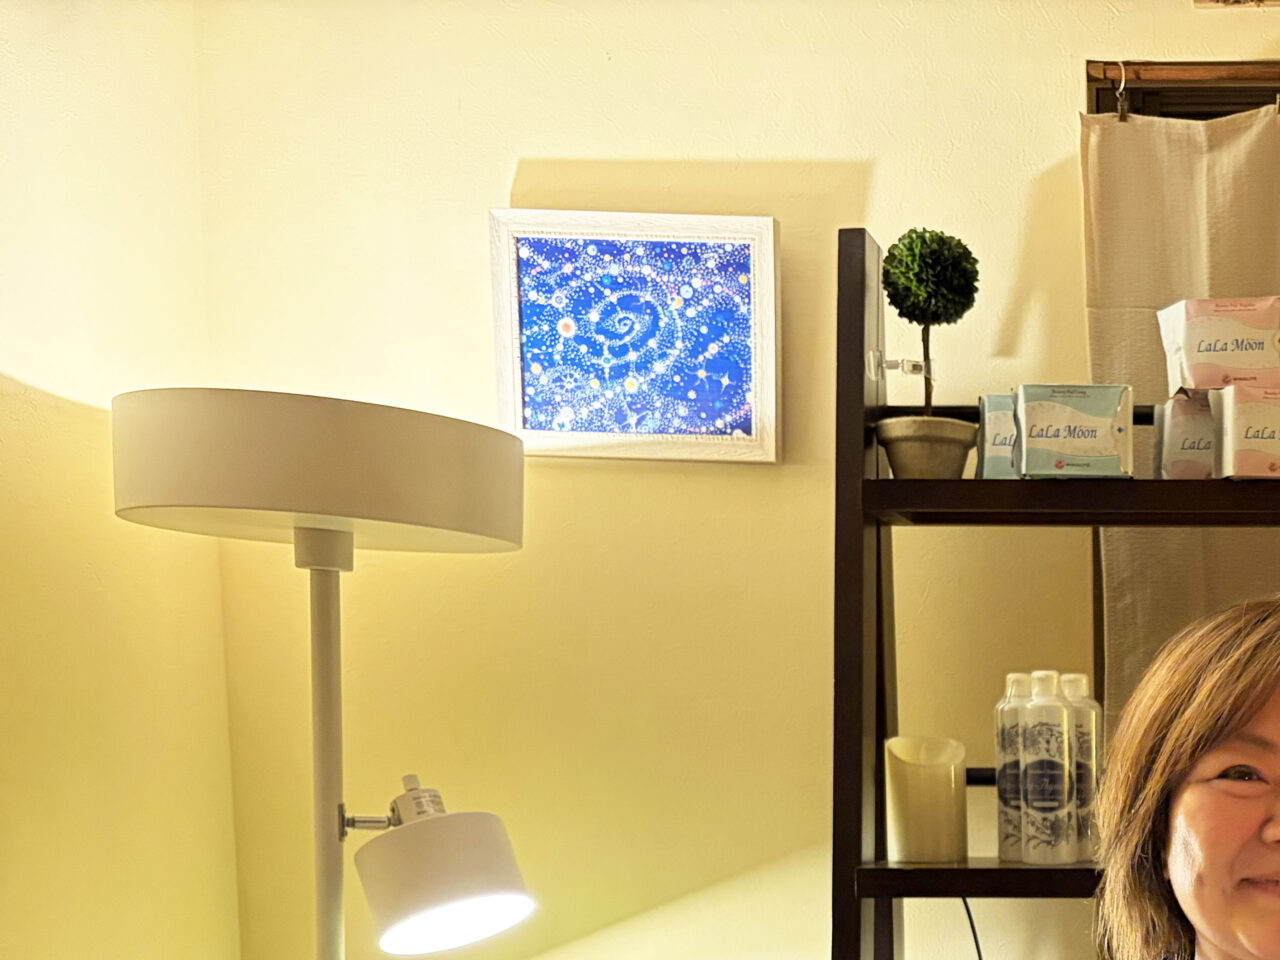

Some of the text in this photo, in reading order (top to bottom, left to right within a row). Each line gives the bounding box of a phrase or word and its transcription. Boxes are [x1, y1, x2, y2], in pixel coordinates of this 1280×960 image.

[1197, 339, 1229, 353] LaLa
[1028, 424, 1060, 438] LaLa
[1244, 426, 1276, 440] LaLa
[992, 432, 1016, 446] LaL
[1180, 438, 1211, 450] LaLa
